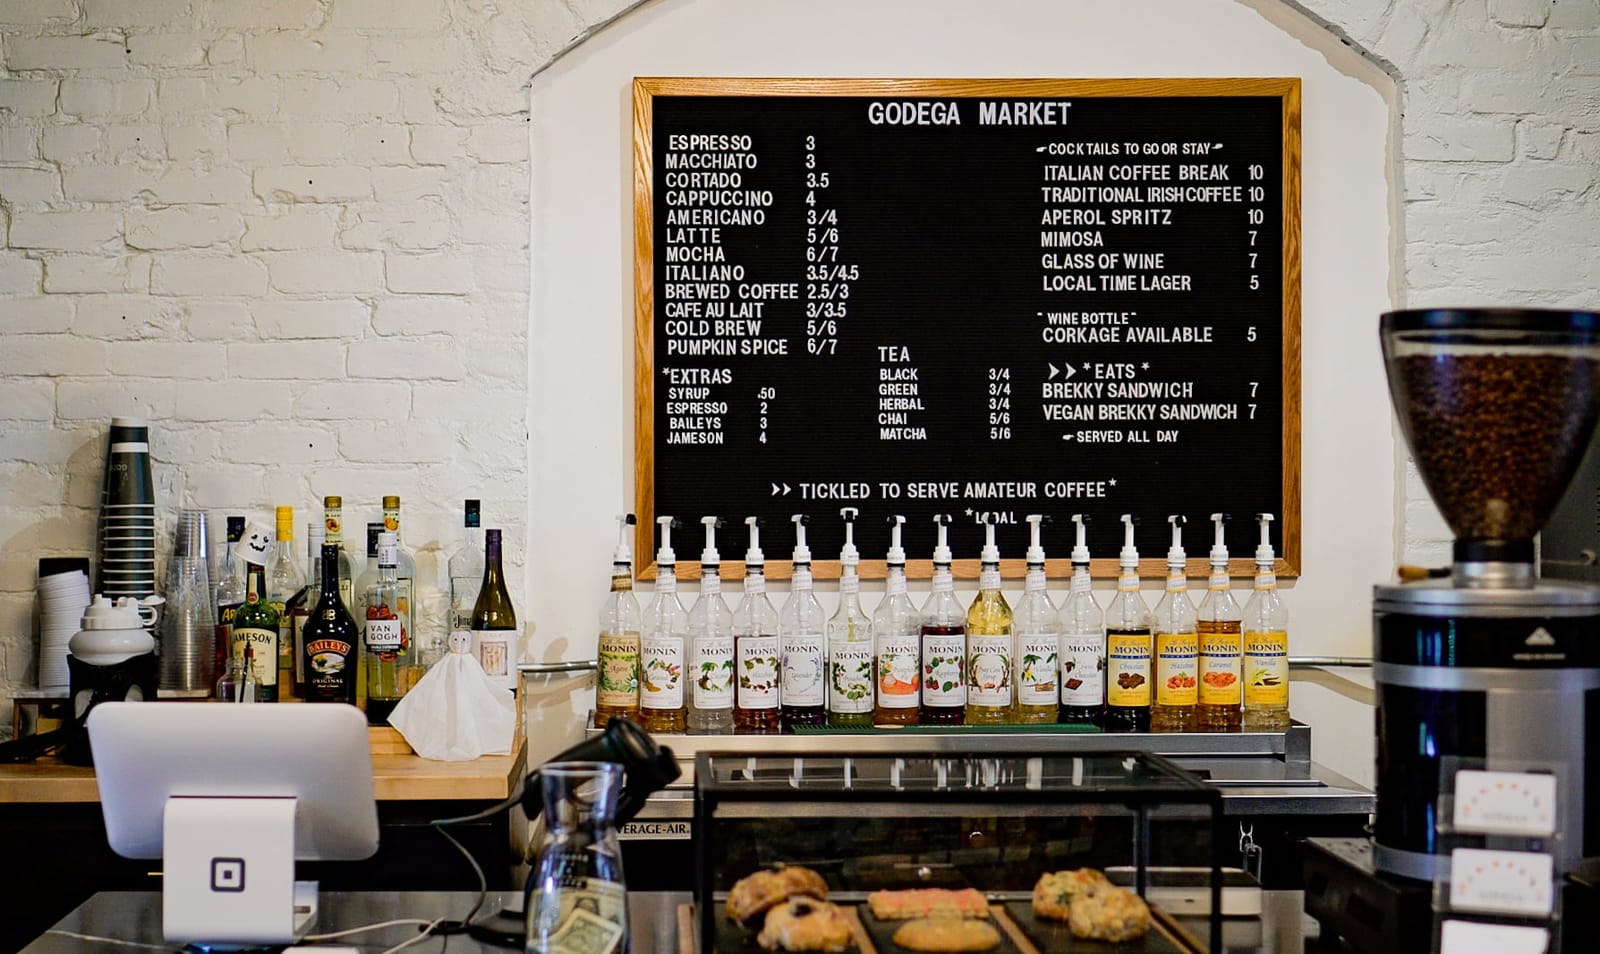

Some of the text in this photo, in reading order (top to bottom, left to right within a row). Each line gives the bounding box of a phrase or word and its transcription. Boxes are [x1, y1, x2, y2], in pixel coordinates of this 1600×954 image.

[869, 102, 1071, 125] GODEGA MARKET
[670, 135, 815, 150] ESPRESSO 3
[1124, 143, 1139, 154] TO
[1183, 143, 1210, 155] STAY
[666, 153, 815, 169] MACCHIATO 3
[666, 173, 829, 188] CORTADO 3.5
[1045, 165, 1263, 181] ITALIAN COFFEE BREAK 10
[666, 191, 816, 206] CAPPUCCINO 4
[1042, 187, 1144, 202] TRADITIONAL
[1249, 187, 1264, 201] 10
[667, 209, 837, 225] AMERICANO 3/4
[1042, 209, 1263, 225] APEROL SPRITZ 10
[667, 228, 838, 243] LATTE 5/6
[1041, 231, 1257, 247] MIMOSA 7
[667, 246, 838, 262] MOCHA 6/7
[1042, 253, 1257, 269] GLASS OF WINE 7
[666, 265, 859, 281] ITALIANO 3.5/4.5
[1044, 275, 1259, 291] LOCAL TIME LAGER 5
[665, 283, 848, 299] BREWED COFFEE 2.5/3
[666, 302, 846, 318] CAFE AU LAIT 3/3.5
[1048, 313, 1128, 324] WINE BOTTLE
[666, 320, 836, 336] COLD BREW 5/6
[1043, 327, 1256, 343] CORKAGE AVAILABLE 5
[668, 338, 837, 355] PUMPKIN SPICE 6/7
[878, 346, 910, 362] TEA
[880, 368, 1010, 380] BLACK 3/4
[669, 387, 775, 399] SYRUP .50
[879, 383, 1011, 395] GREEN 3/4
[1043, 382, 1258, 398] BREKKY SANDWICH 7
[667, 402, 767, 414] ESPRESSO 2
[880, 398, 1010, 410] HERBAL 3/4
[879, 412, 1009, 424] CHAI 5/6
[1043, 404, 1256, 420] VEGAN BREKKY SANDWICH 7
[670, 417, 767, 429] BAILEYS 3
[667, 432, 766, 444] JAMESON 4
[881, 427, 1010, 440] MATCHA 5/6
[1077, 430, 1178, 442] SERVED ALL DAY
[800, 483, 870, 499] TICKLED
[879, 483, 900, 498] TO
[908, 483, 958, 498] SERVE
[964, 482, 1036, 498] AMATEUR
[234, 632, 272, 645] AMESON
[371, 633, 398, 641] GOGH
[308, 640, 348, 653] BAILEYS
[602, 644, 636, 653] MONIN
[784, 645, 819, 653] MONIN
[972, 645, 1007, 653] MONIN
[1203, 644, 1238, 652] MONIN
[1248, 643, 1283, 651] MONIN
[835, 651, 870, 659] MONIN
